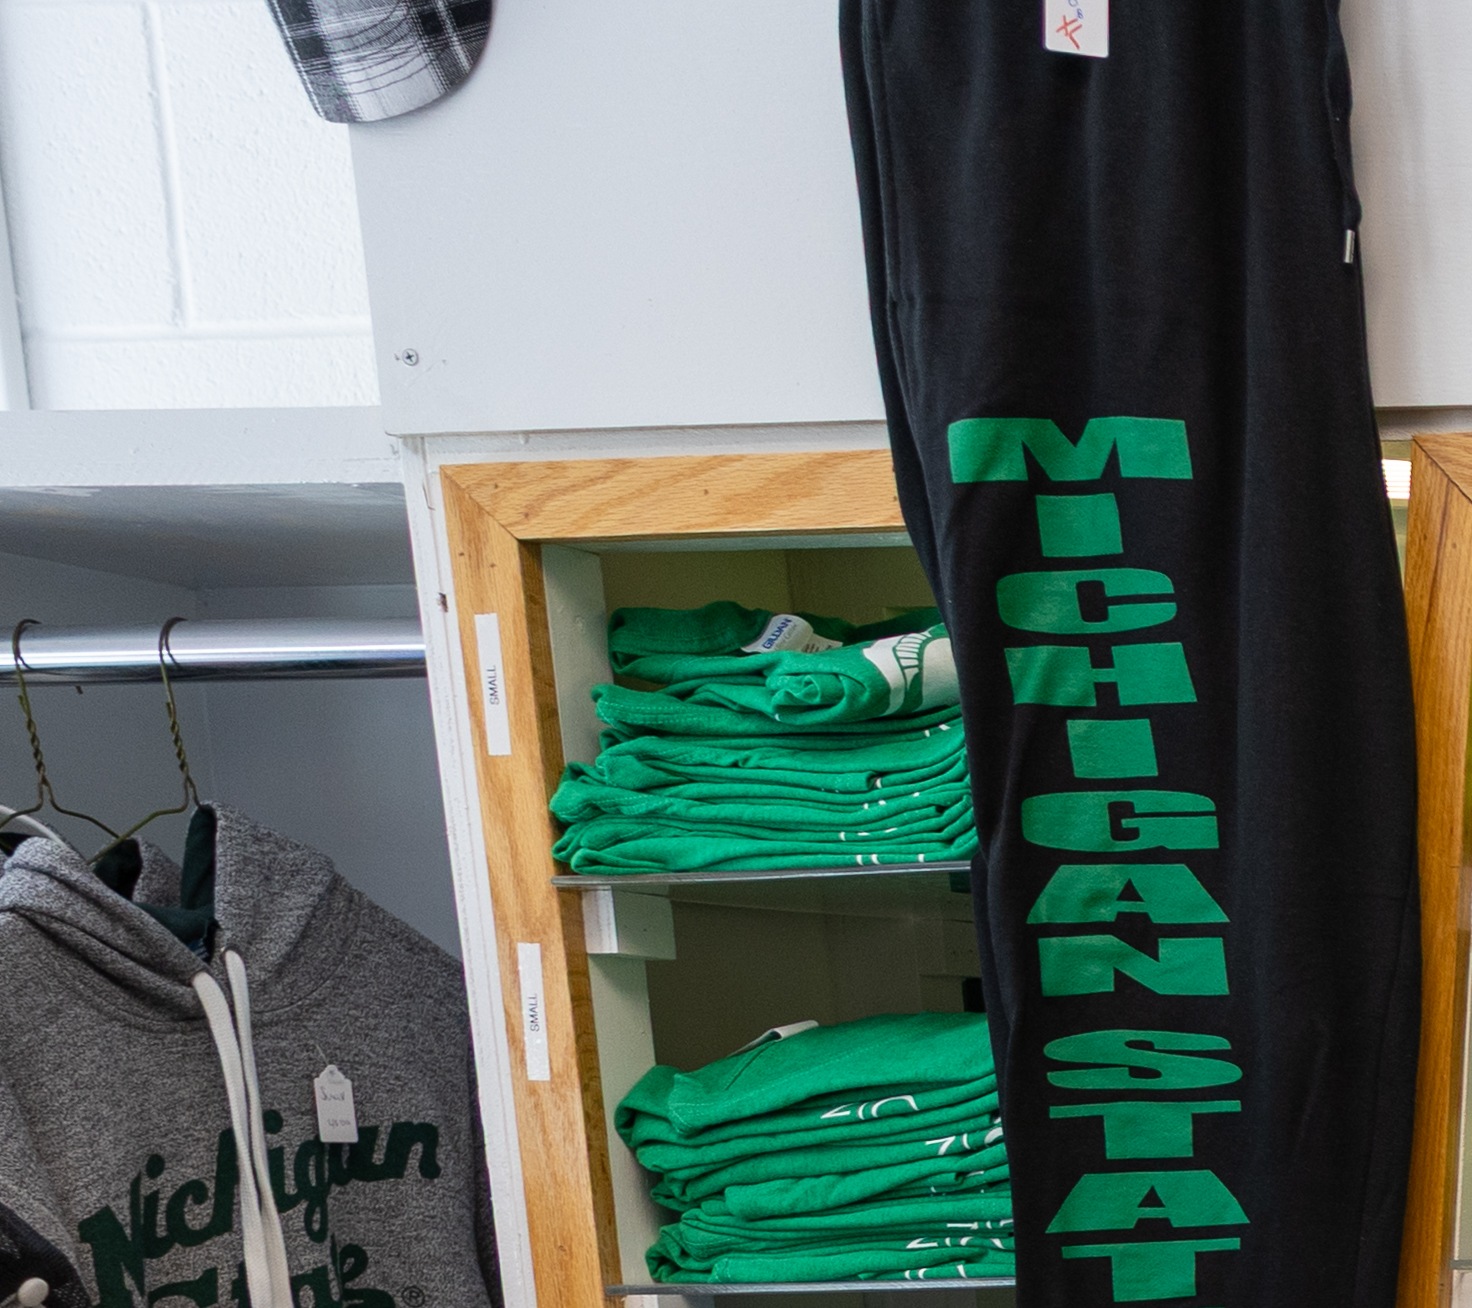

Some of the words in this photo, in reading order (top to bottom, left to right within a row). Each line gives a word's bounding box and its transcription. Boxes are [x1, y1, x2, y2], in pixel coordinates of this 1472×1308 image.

[486, 664, 499, 706] SMALL
[948, 415, 1231, 996] MICHIGAN
[527, 993, 541, 1032] SMALL
